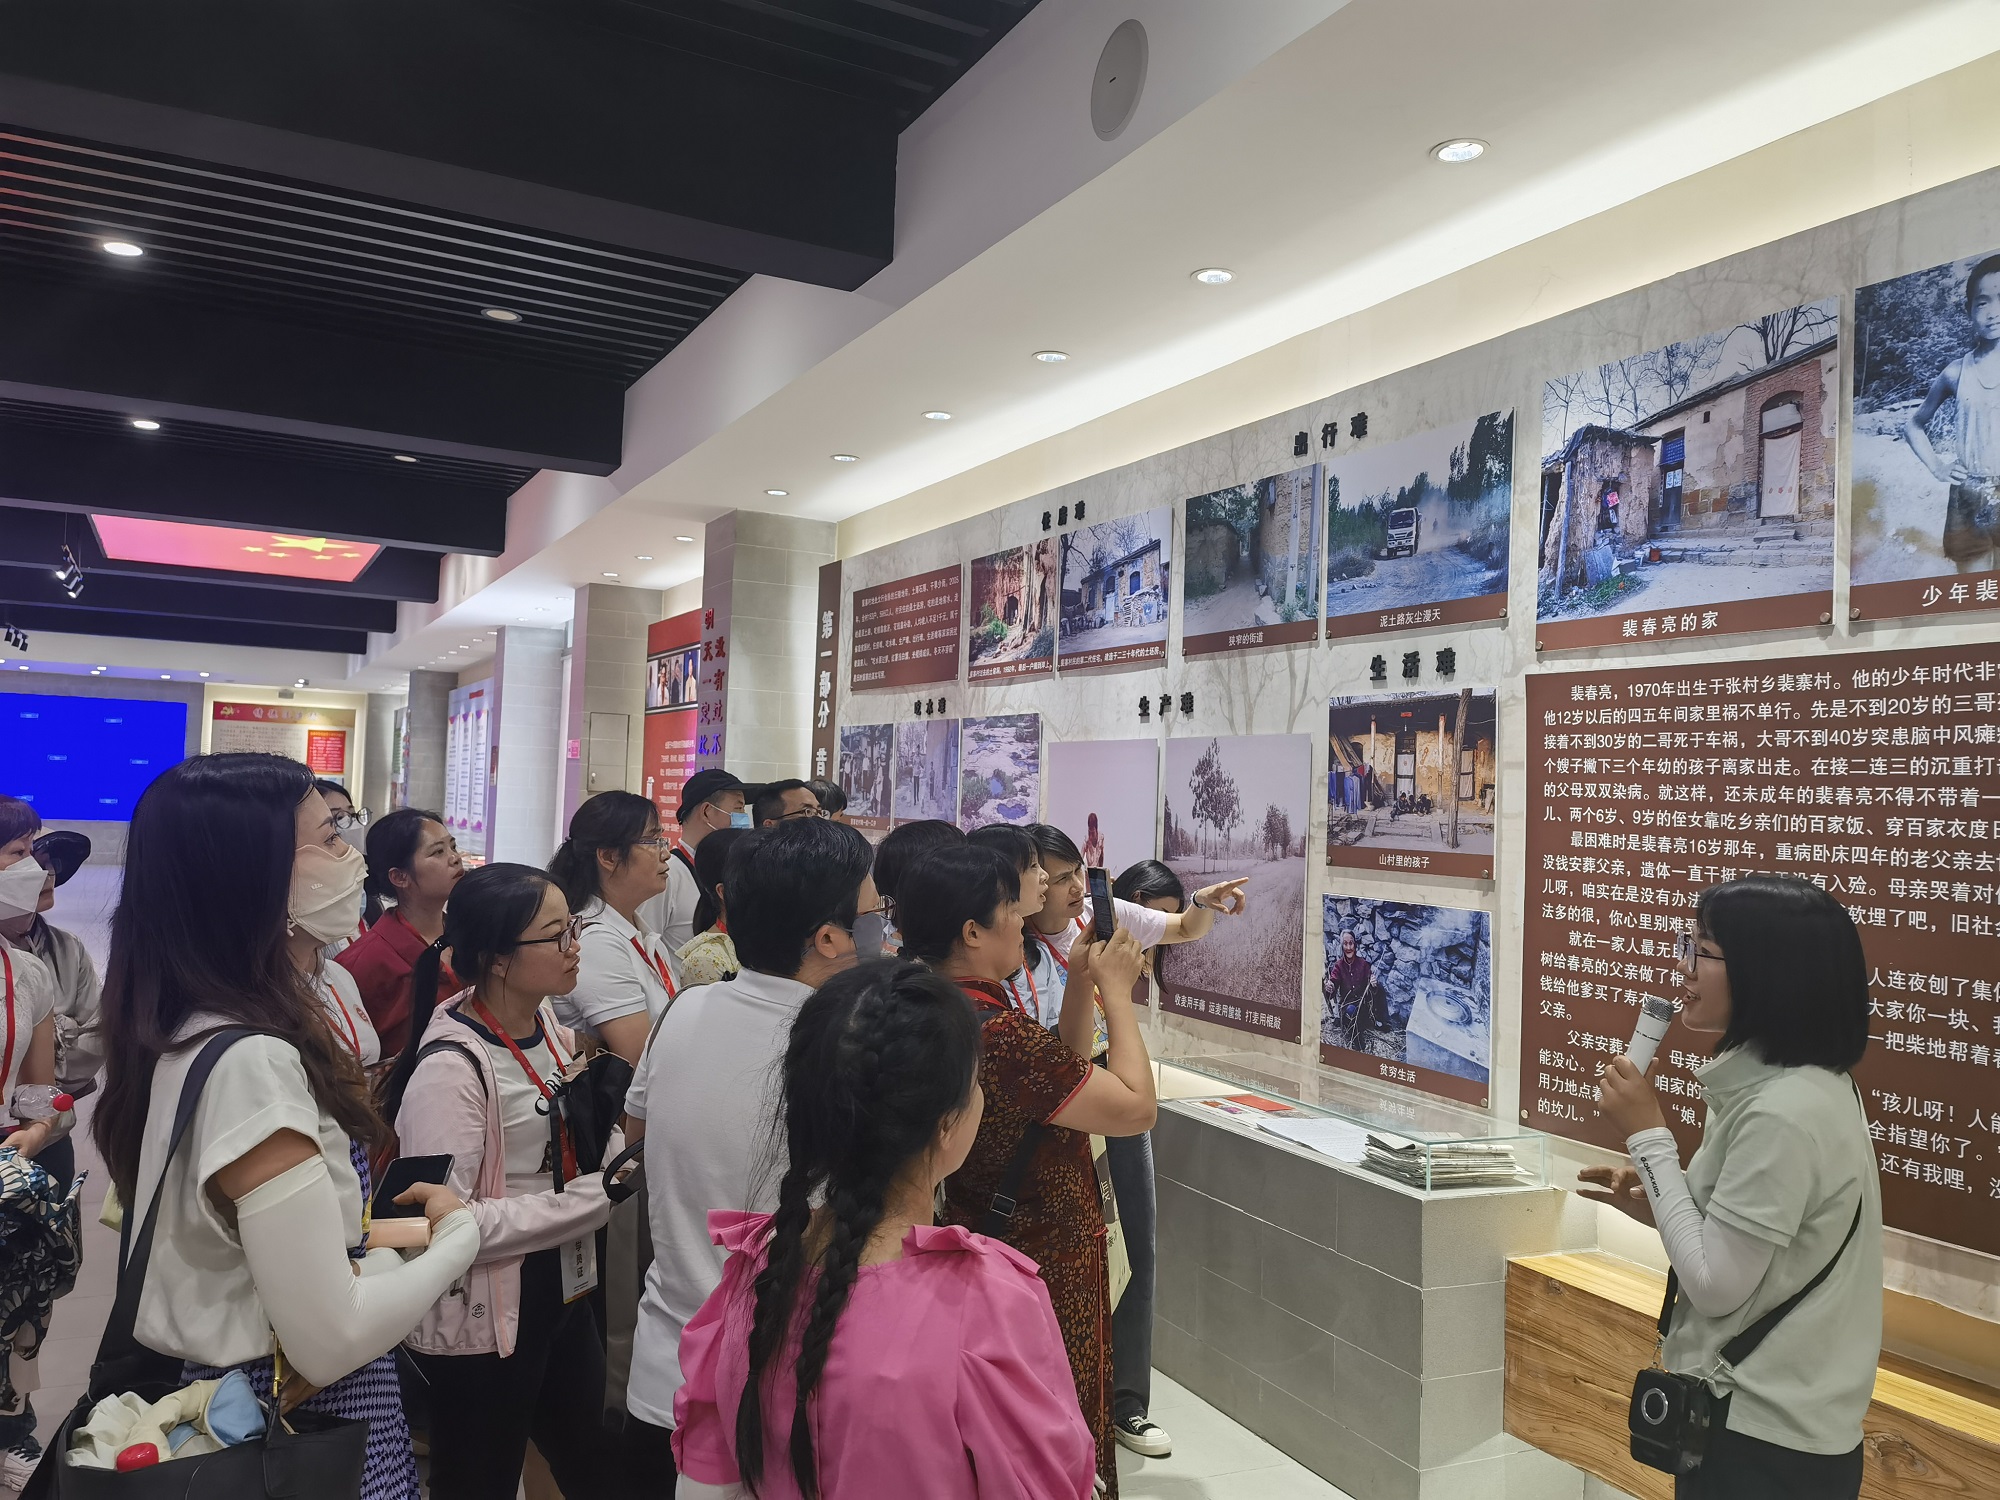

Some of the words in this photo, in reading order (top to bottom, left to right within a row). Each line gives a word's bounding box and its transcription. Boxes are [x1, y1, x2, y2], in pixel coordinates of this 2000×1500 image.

[1294, 412, 1369, 457] 出行难
[1041, 501, 1086, 531] 住房难
[1922, 578, 1999, 607] 少年裴
[1379, 608, 1441, 628] 泥土路灰尘漫天
[1622, 611, 1718, 638] 裴春亮的家
[1228, 631, 1264, 646] 狭窄的街道
[817, 610, 834, 728] 第一部分
[1370, 647, 1456, 681] 生活难
[1571, 661, 2000, 701] 裴春亮，1970年出生于张村乡裴寨村。他的少年时代非
[914, 697, 947, 716] 吃水难
[1138, 692, 1195, 716] 生产难
[1544, 692, 2000, 726] 他12岁以后的四五年间家里祸不单行。先是不到20岁的三哥
[1544, 724, 2000, 750] 接着不到30岁的二哥死于车祸，大哥不到40岁突患脑中风瘫
[1544, 756, 2000, 776] 个嫂子撇下三个年幼的孩子离家出走。在接二连三的沉重打
[1379, 853, 1430, 868] 山村里的孩子
[1570, 831, 2000, 872] 最困难时是裴春亮16岁那年，重病卧床四年的老父亲去
[1540, 1000, 1572, 1021] 父亲。
[1379, 1063, 1416, 1083] 贫穷生活
